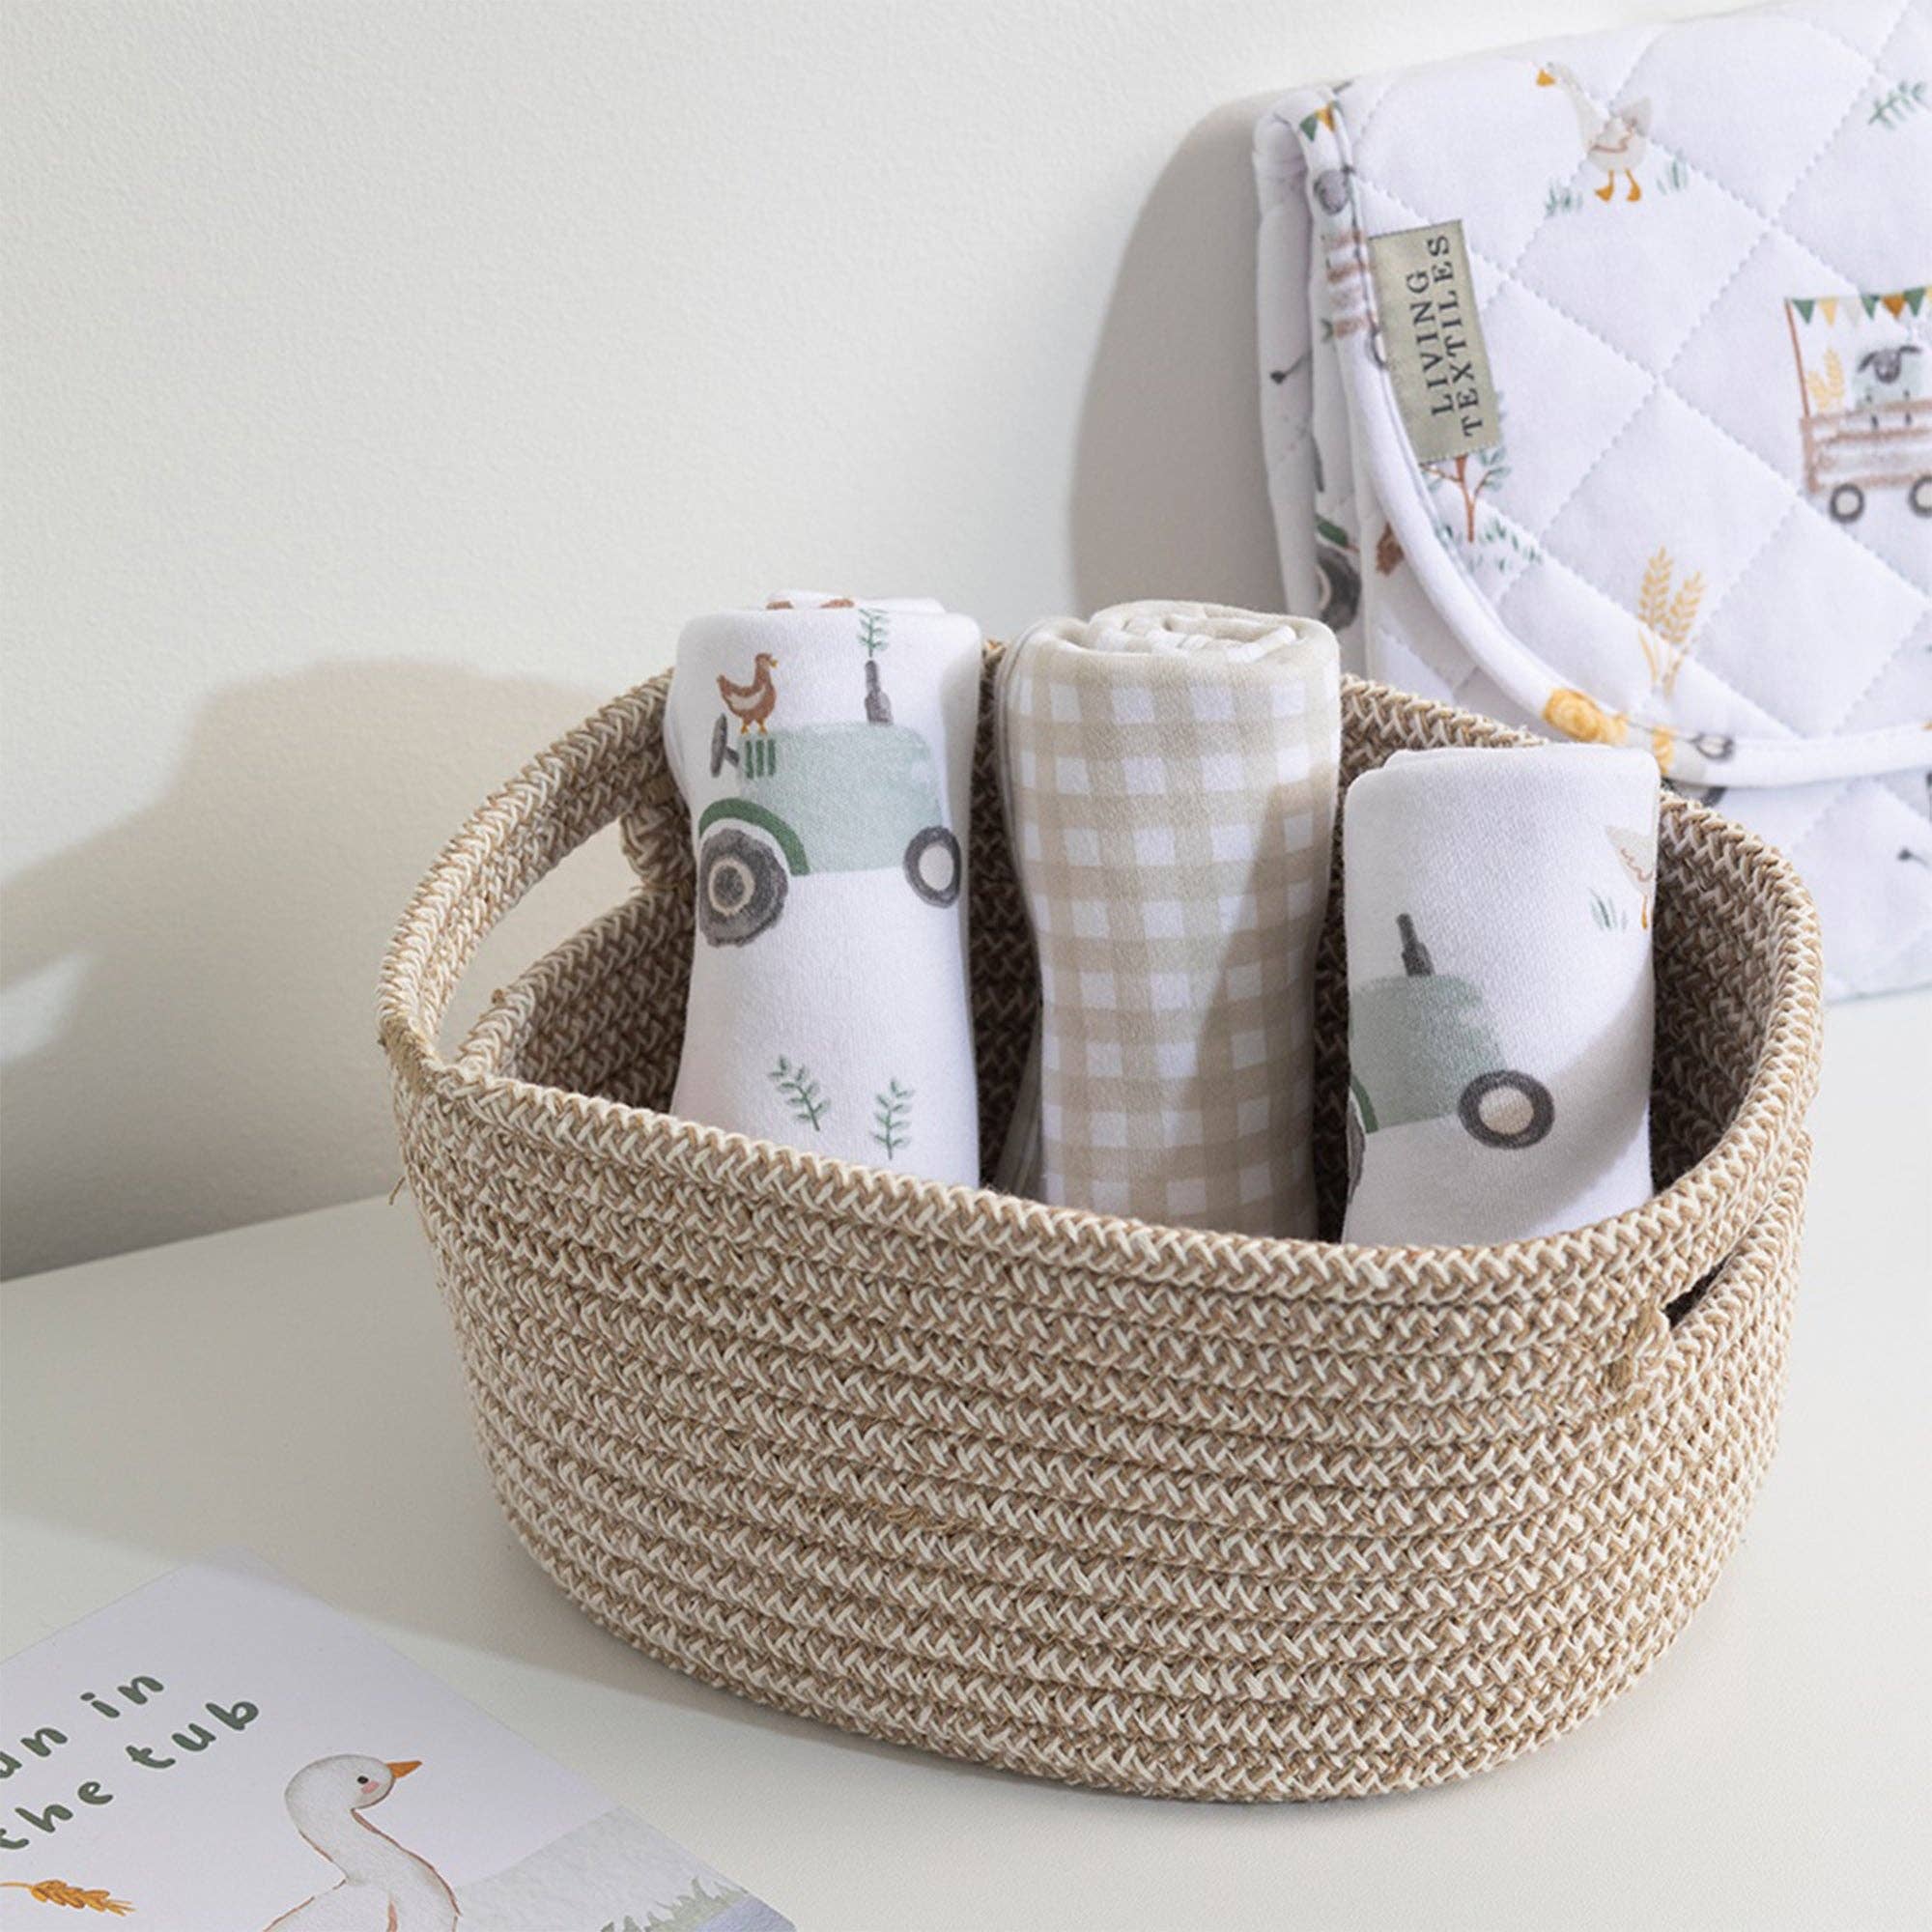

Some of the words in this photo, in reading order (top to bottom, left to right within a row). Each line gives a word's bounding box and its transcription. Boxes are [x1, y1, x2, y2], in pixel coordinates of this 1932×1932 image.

[1406, 270, 1455, 416] LIVING
[1428, 235, 1484, 438] TEXTILES
[80, 1675, 164, 1719] in
[126, 1701, 260, 1770] tub
